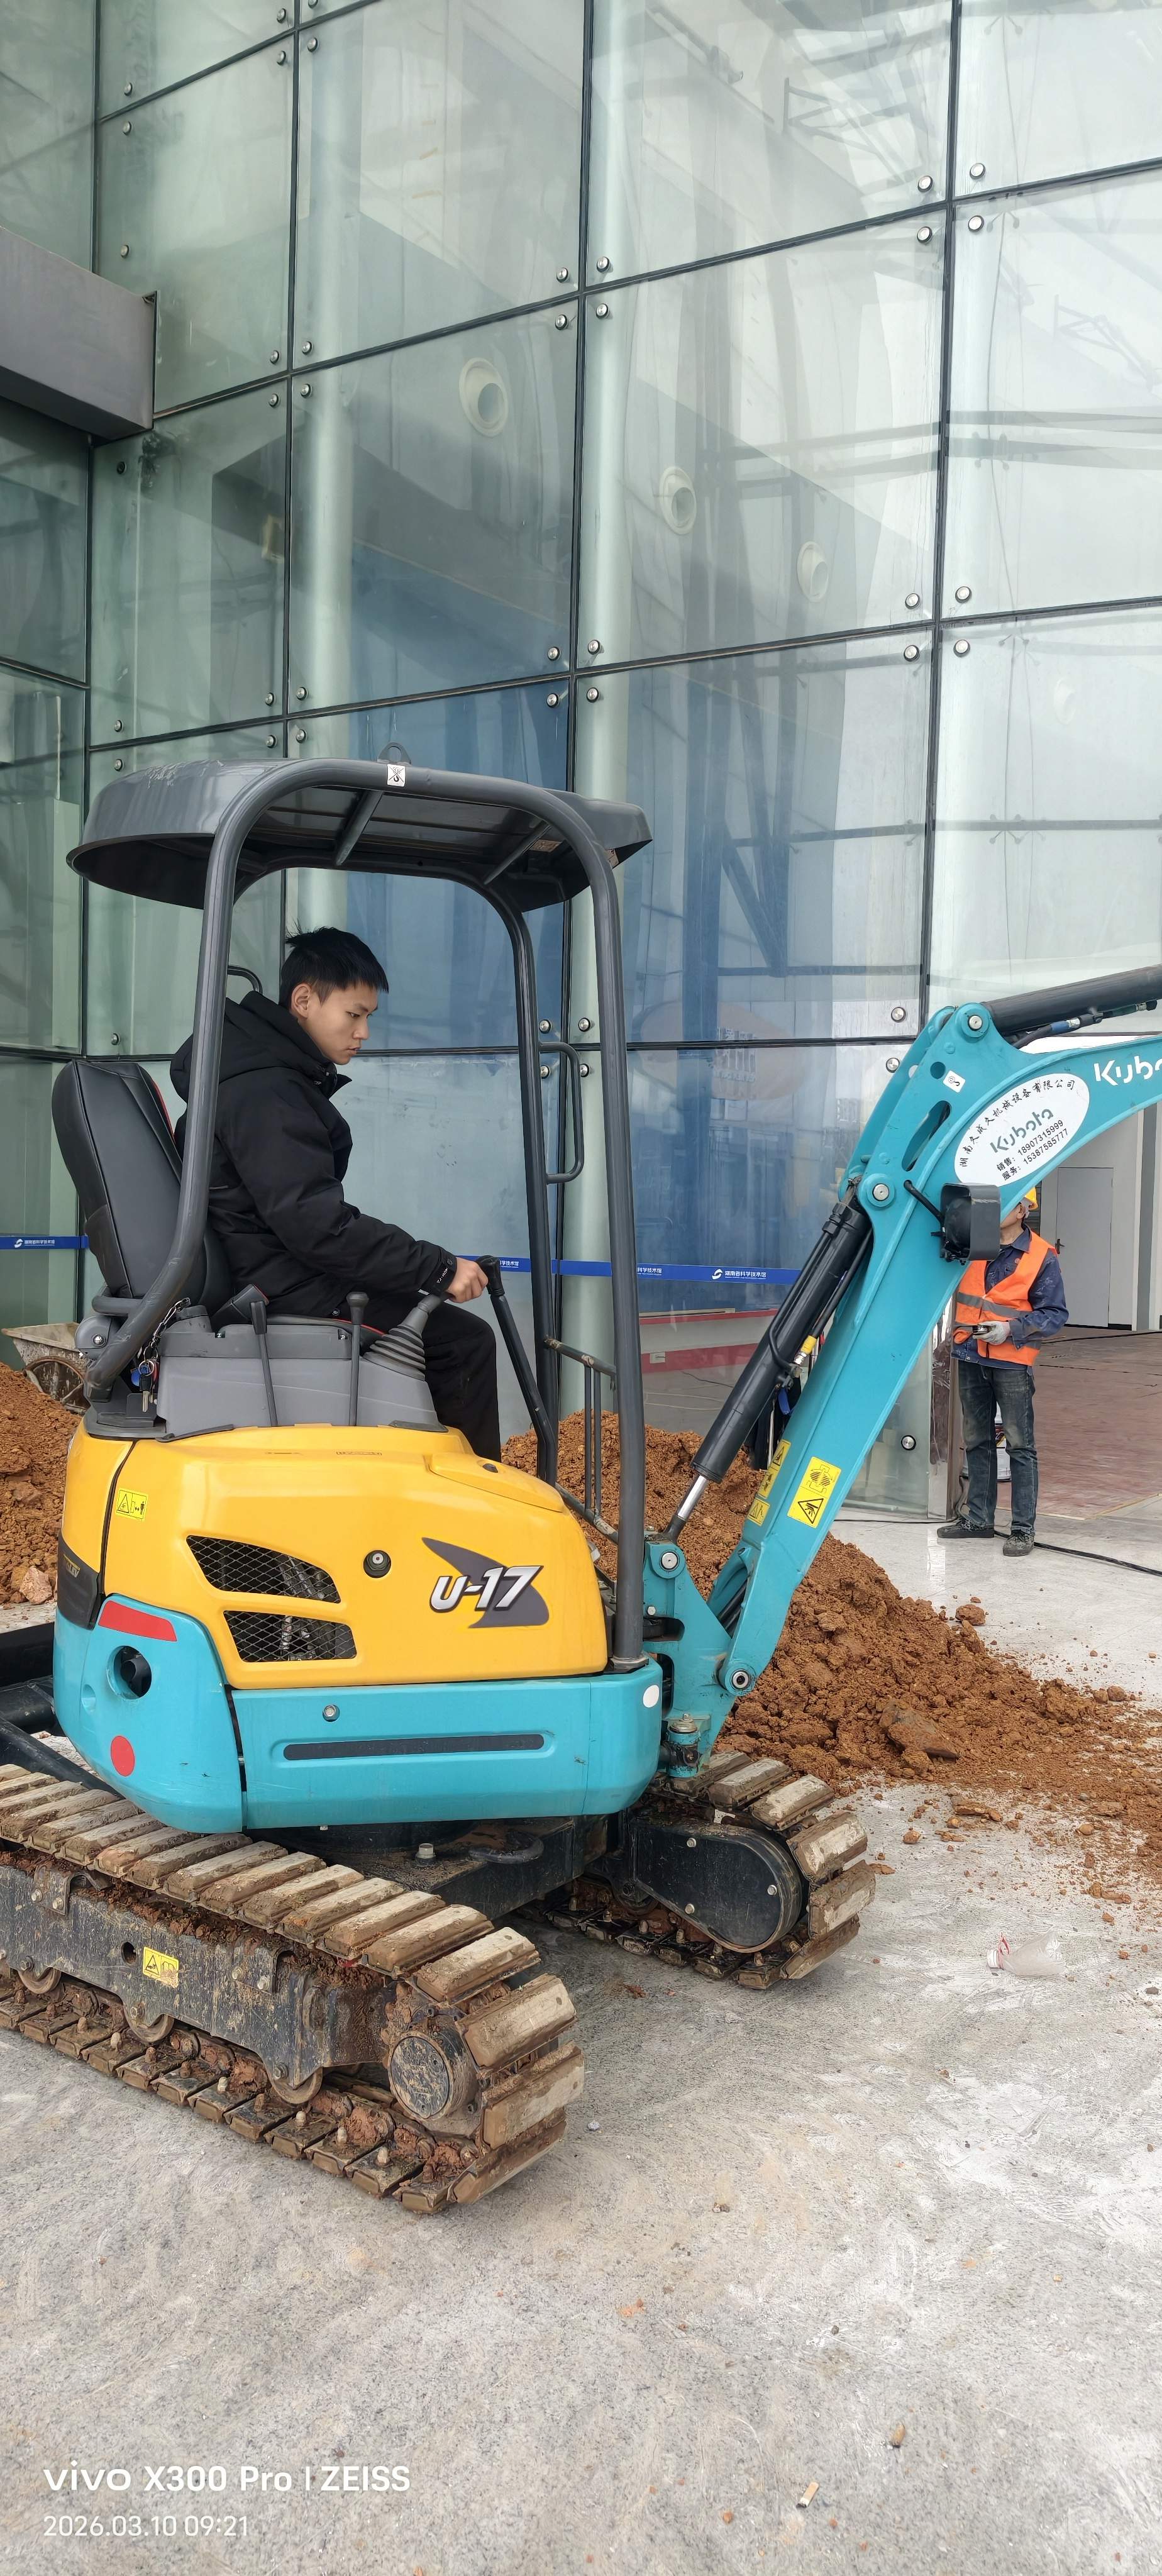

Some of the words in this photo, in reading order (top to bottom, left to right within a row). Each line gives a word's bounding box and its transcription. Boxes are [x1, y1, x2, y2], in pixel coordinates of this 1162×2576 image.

[990, 1109, 1054, 1153] Kubota
[1017, 1119, 1064, 1156] 18907315999
[1023, 1128, 1068, 1165] 15387585777
[429, 1565, 544, 1613] U-17
